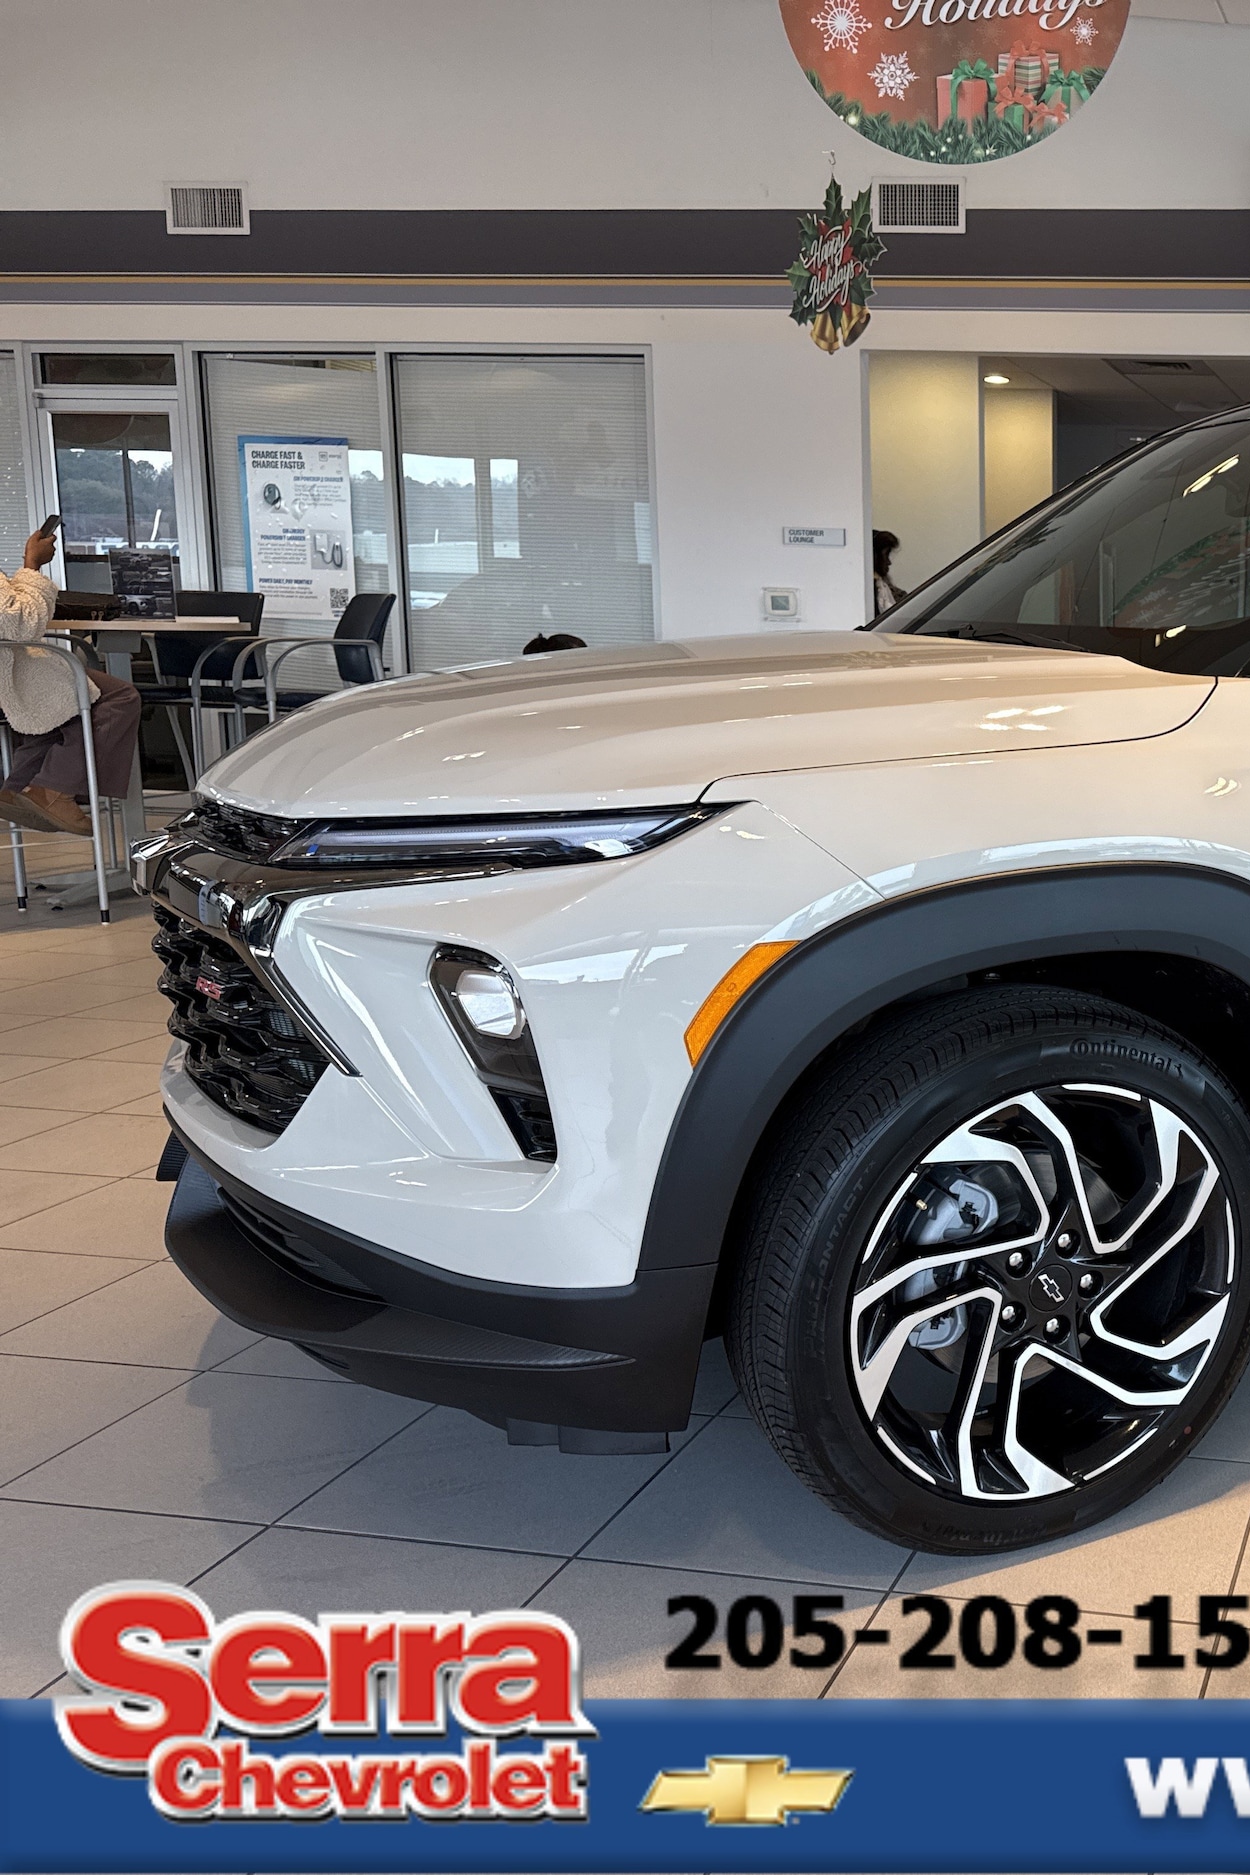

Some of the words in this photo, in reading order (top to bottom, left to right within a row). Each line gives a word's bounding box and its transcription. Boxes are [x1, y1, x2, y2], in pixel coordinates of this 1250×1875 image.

[800, 226, 853, 271] Happy
[802, 259, 863, 309] Holidays
[251, 450, 279, 460] CHARGE
[279, 451, 297, 460] FAST
[297, 451, 304, 460] &
[252, 460, 280, 469] CHARGE
[280, 461, 306, 470] FASTER
[788, 529, 825, 537] CUSTOMER
[195, 976, 225, 1000] RS
[1069, 1037, 1173, 1073] Continental
